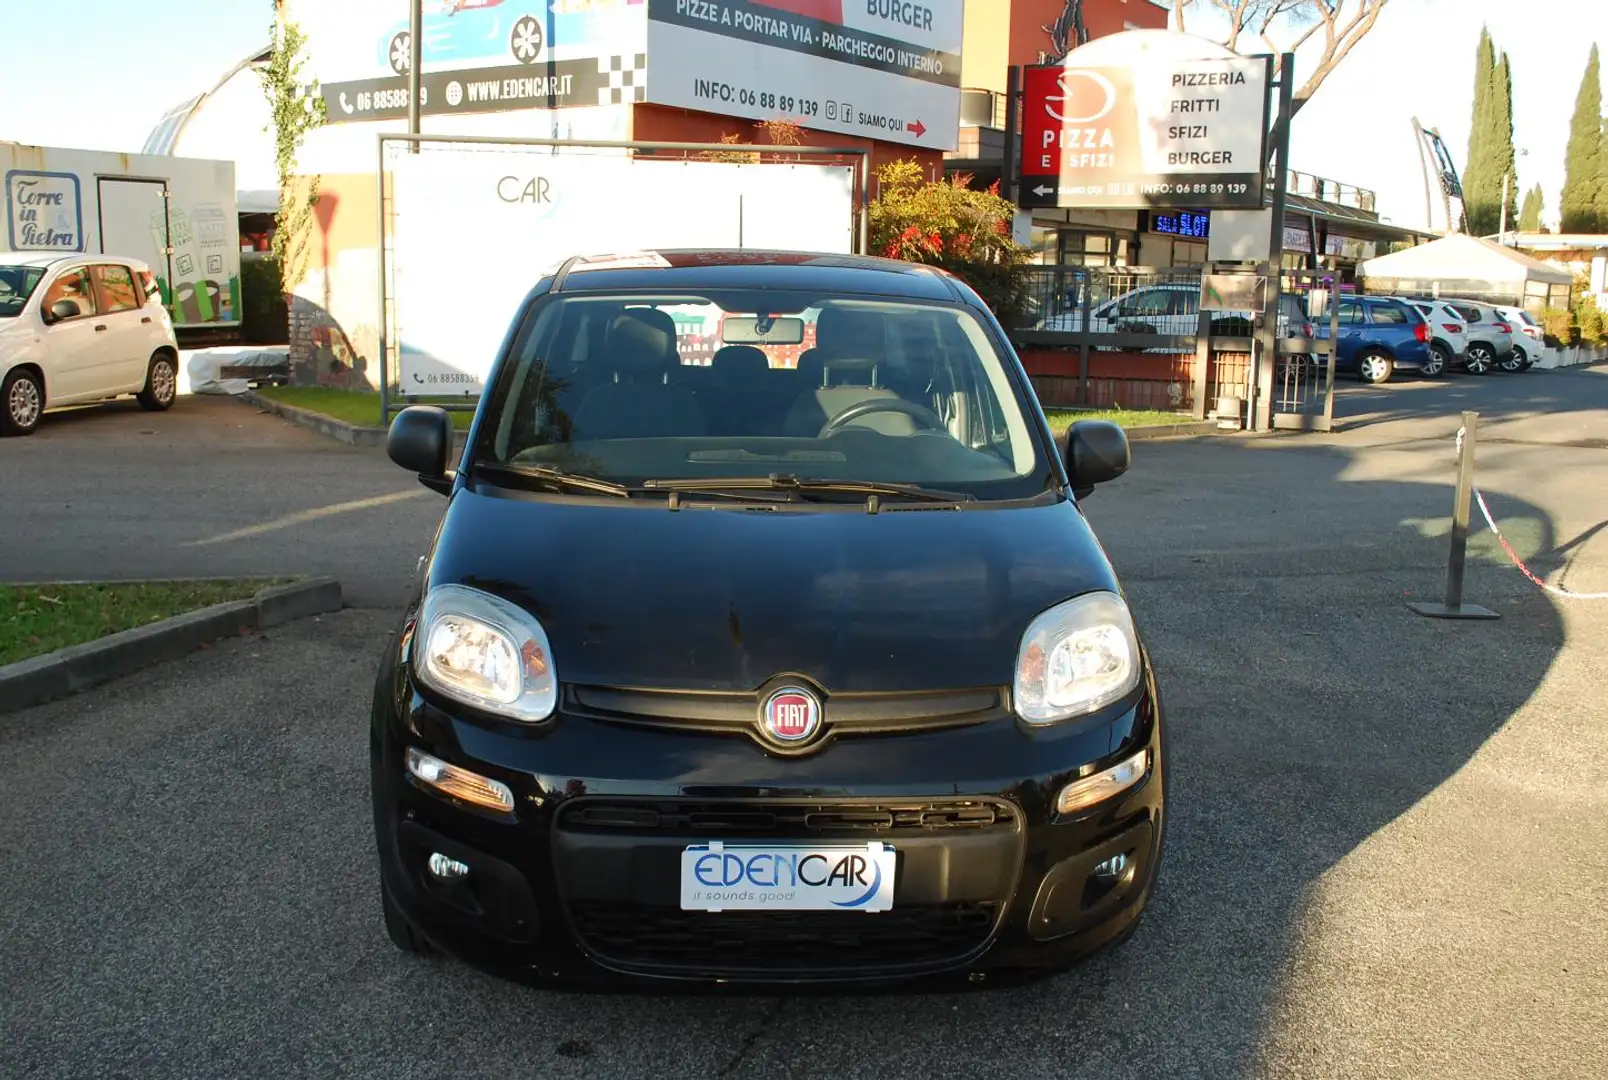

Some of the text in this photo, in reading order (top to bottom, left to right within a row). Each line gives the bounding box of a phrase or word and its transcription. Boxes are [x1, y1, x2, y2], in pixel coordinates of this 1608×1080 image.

[867, 0, 933, 31] BURGER
[677, 0, 942, 76] PIZZE A PORTAR VIA PARCHEGGIO INTERNO
[467, 74, 573, 102] WWW.EDENCAR.IT
[1172, 72, 1246, 87] PIZZERIA
[357, 87, 428, 110] 06 885889
[694, 79, 903, 132] INFO: 06 88 89 139 SIAMO QUI
[1170, 98, 1220, 113] FRITTI
[1042, 128, 1114, 149] PIZZA
[1168, 126, 1208, 139] SFIZI
[1041, 152, 1114, 168] E SFIZI
[1168, 151, 1232, 165] BURGER
[17, 181, 64, 206] Torre
[497, 176, 552, 204] CAR
[1140, 184, 1173, 194] INFO:
[1176, 184, 1190, 194] 06
[1193, 184, 1207, 194] 88
[1210, 184, 1224, 194] 89
[1227, 183, 1248, 194] 139
[20, 206, 37, 222] in
[1180, 213, 1208, 237] SLOT
[428, 373, 438, 384] 06
[777, 704, 808, 728] FIAT
[694, 854, 868, 887] EDENCAR
[706, 890, 754, 901] sounds
